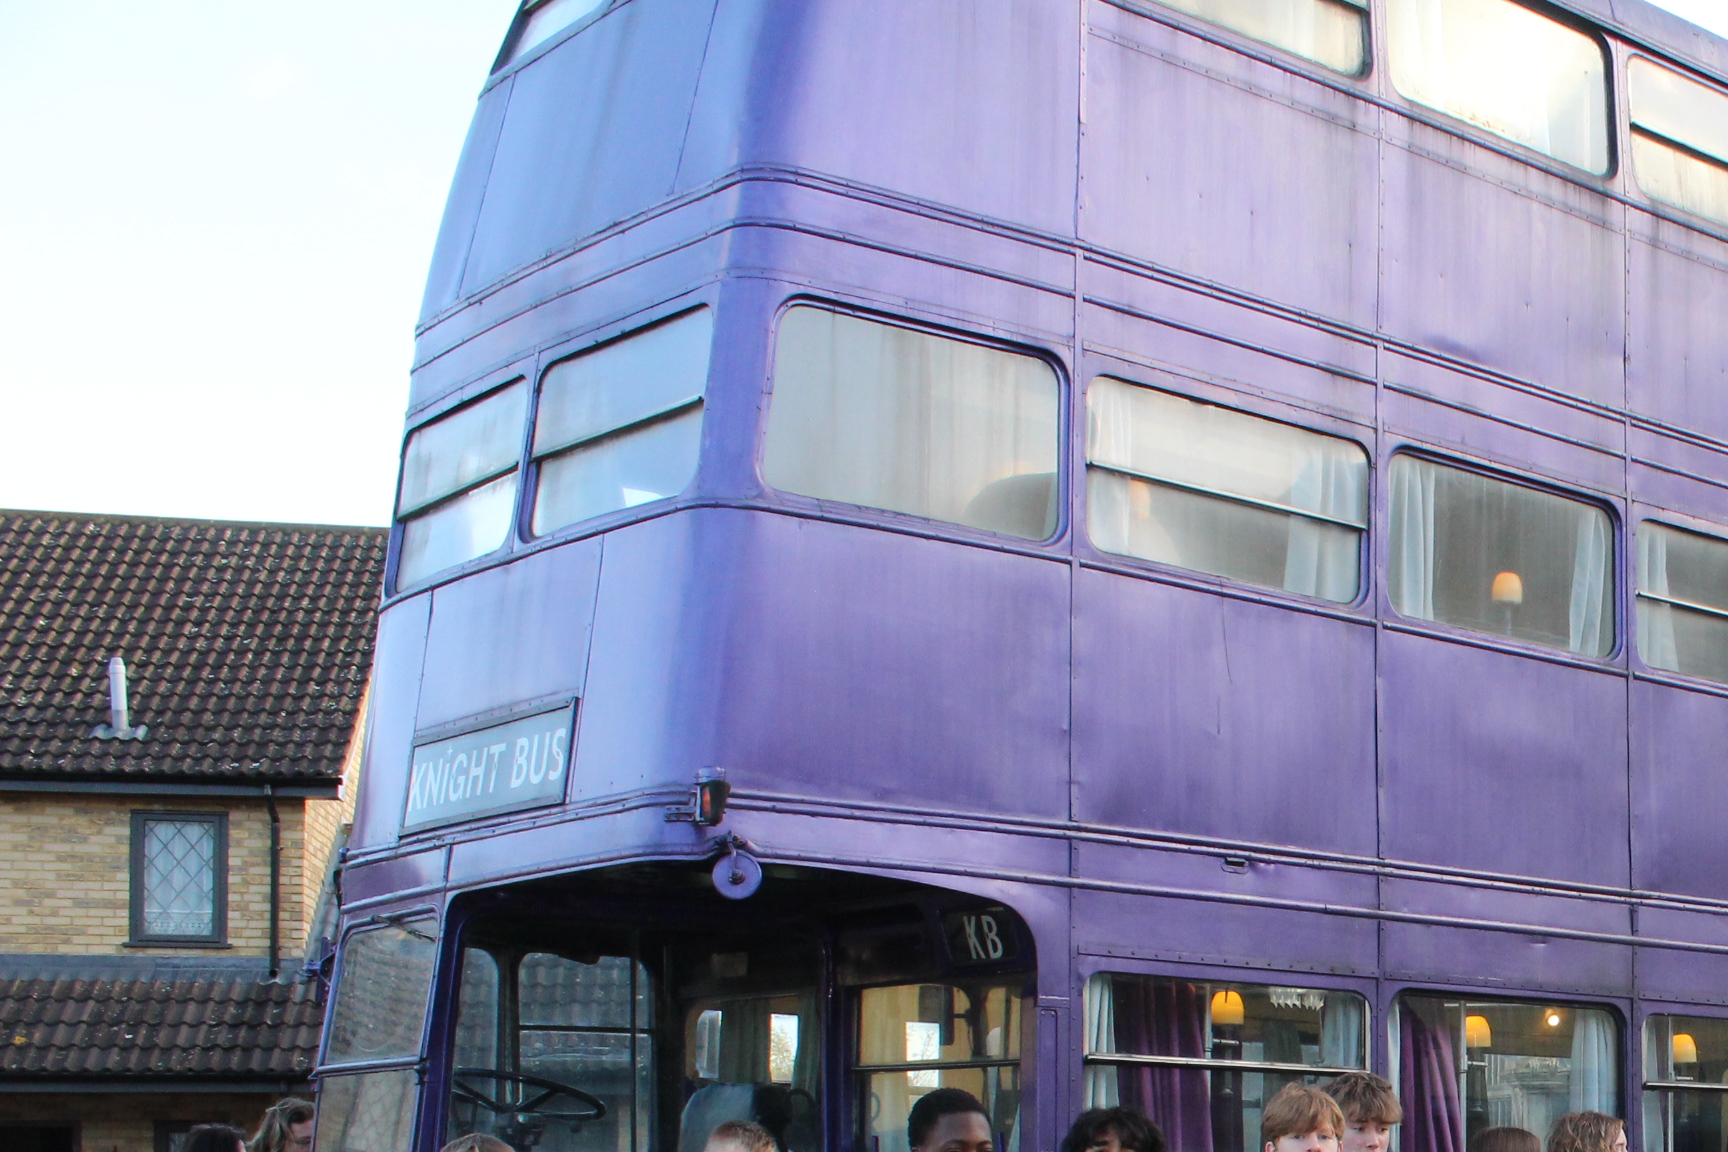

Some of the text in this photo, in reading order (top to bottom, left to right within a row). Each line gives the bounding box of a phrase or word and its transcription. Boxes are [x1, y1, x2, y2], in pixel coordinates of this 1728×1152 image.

[408, 728, 566, 812] KNIGHT BUS
[963, 915, 1003, 959] KB
